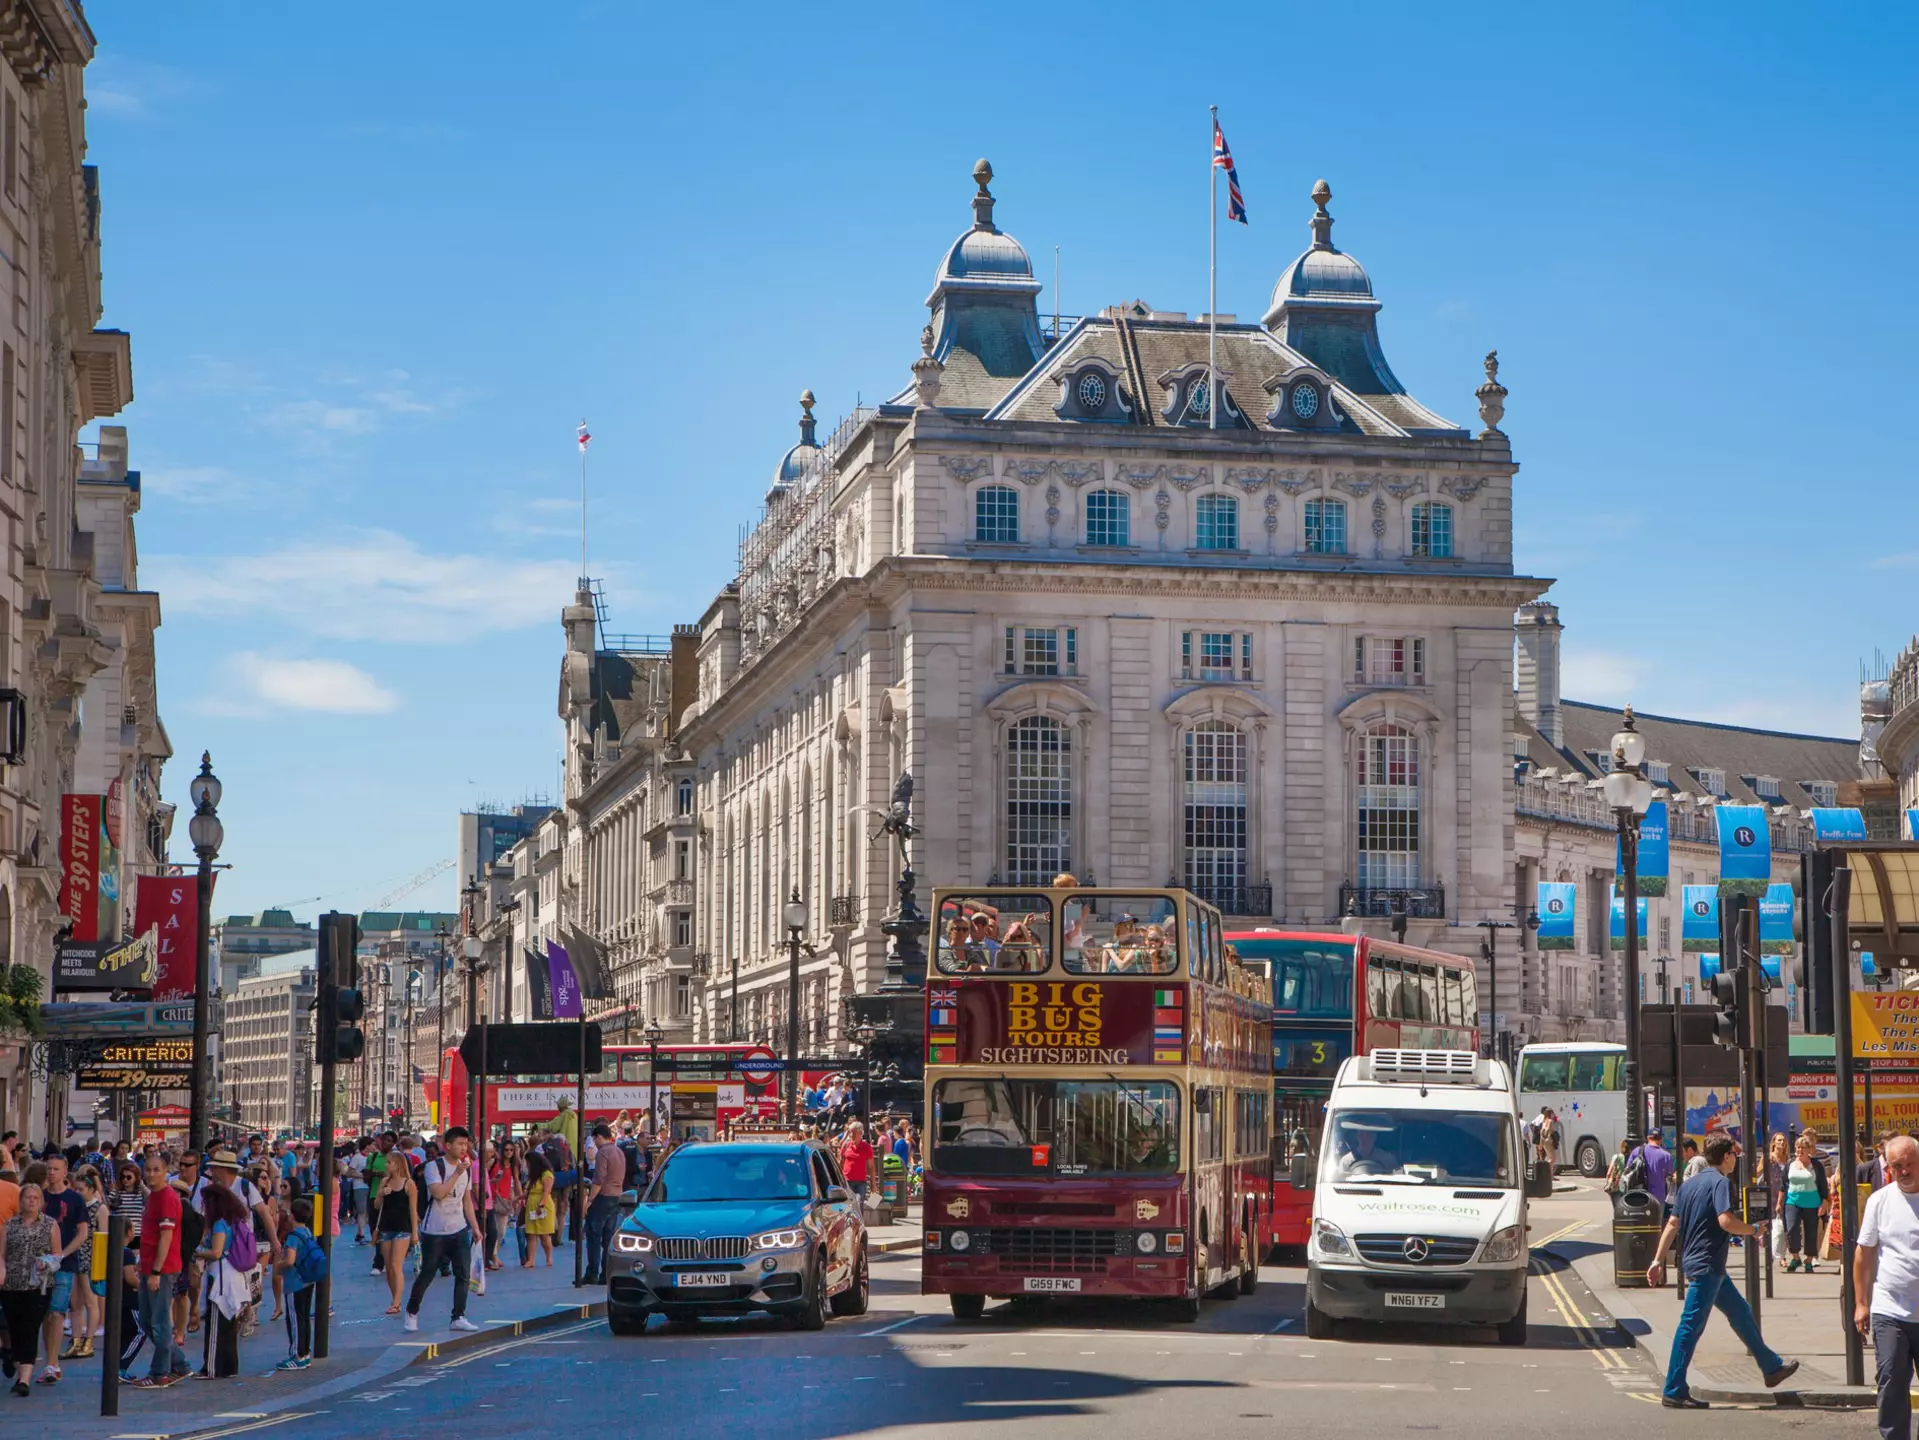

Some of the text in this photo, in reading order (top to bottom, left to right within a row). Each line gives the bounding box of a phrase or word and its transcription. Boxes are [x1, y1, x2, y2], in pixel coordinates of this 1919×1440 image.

[70, 861, 91, 891] 39
[61, 949, 97, 958] HITCHCOCK
[61, 959, 83, 967] MEETS
[1008, 983, 1104, 1007] BIG
[1008, 1007, 1103, 1031] BUS
[1893, 1013, 1918, 1025] The
[1008, 1031, 1101, 1046] TOURS
[1882, 1027, 1907, 1038] The
[1862, 1041, 1887, 1051] Les
[980, 1048, 1129, 1065] SIGHTSEEING
[1311, 1042, 1325, 1064] 3
[734, 1061, 785, 1069] UNDERGROUND
[1893, 1059, 1909, 1067] BUS
[116, 1069, 147, 1088] 39
[142, 1074, 189, 1088] STEPS'
[503, 1092, 541, 1101] THERE
[560, 1092, 590, 1101] ONY
[594, 1092, 618, 1100] ONE
[1804, 1106, 1828, 1120] THE
[1831, 1104, 1890, 1119] OGIAL
[681, 1274, 704, 1285] EJ14
[1030, 1279, 1075, 1290] G159 FWC
[1391, 1295, 1439, 1307] WN61 YFZ
